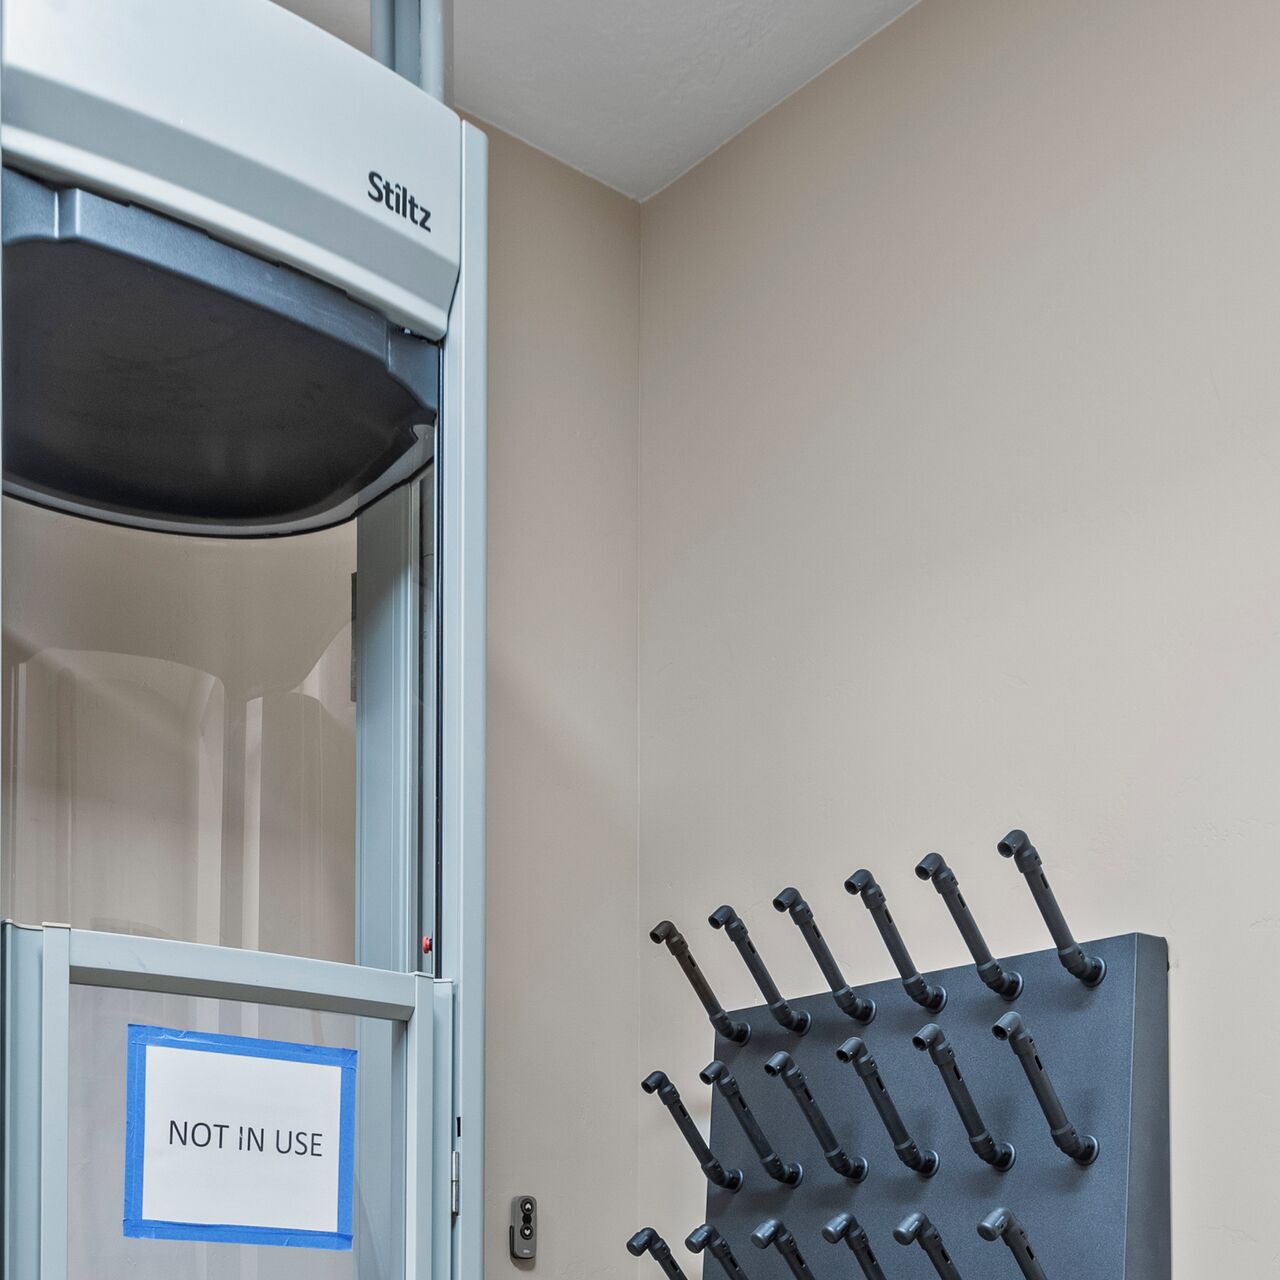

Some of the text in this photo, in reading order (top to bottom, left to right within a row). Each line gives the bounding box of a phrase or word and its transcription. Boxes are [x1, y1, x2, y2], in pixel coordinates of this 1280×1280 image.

[169, 1120, 323, 1157] NOT IN USE
